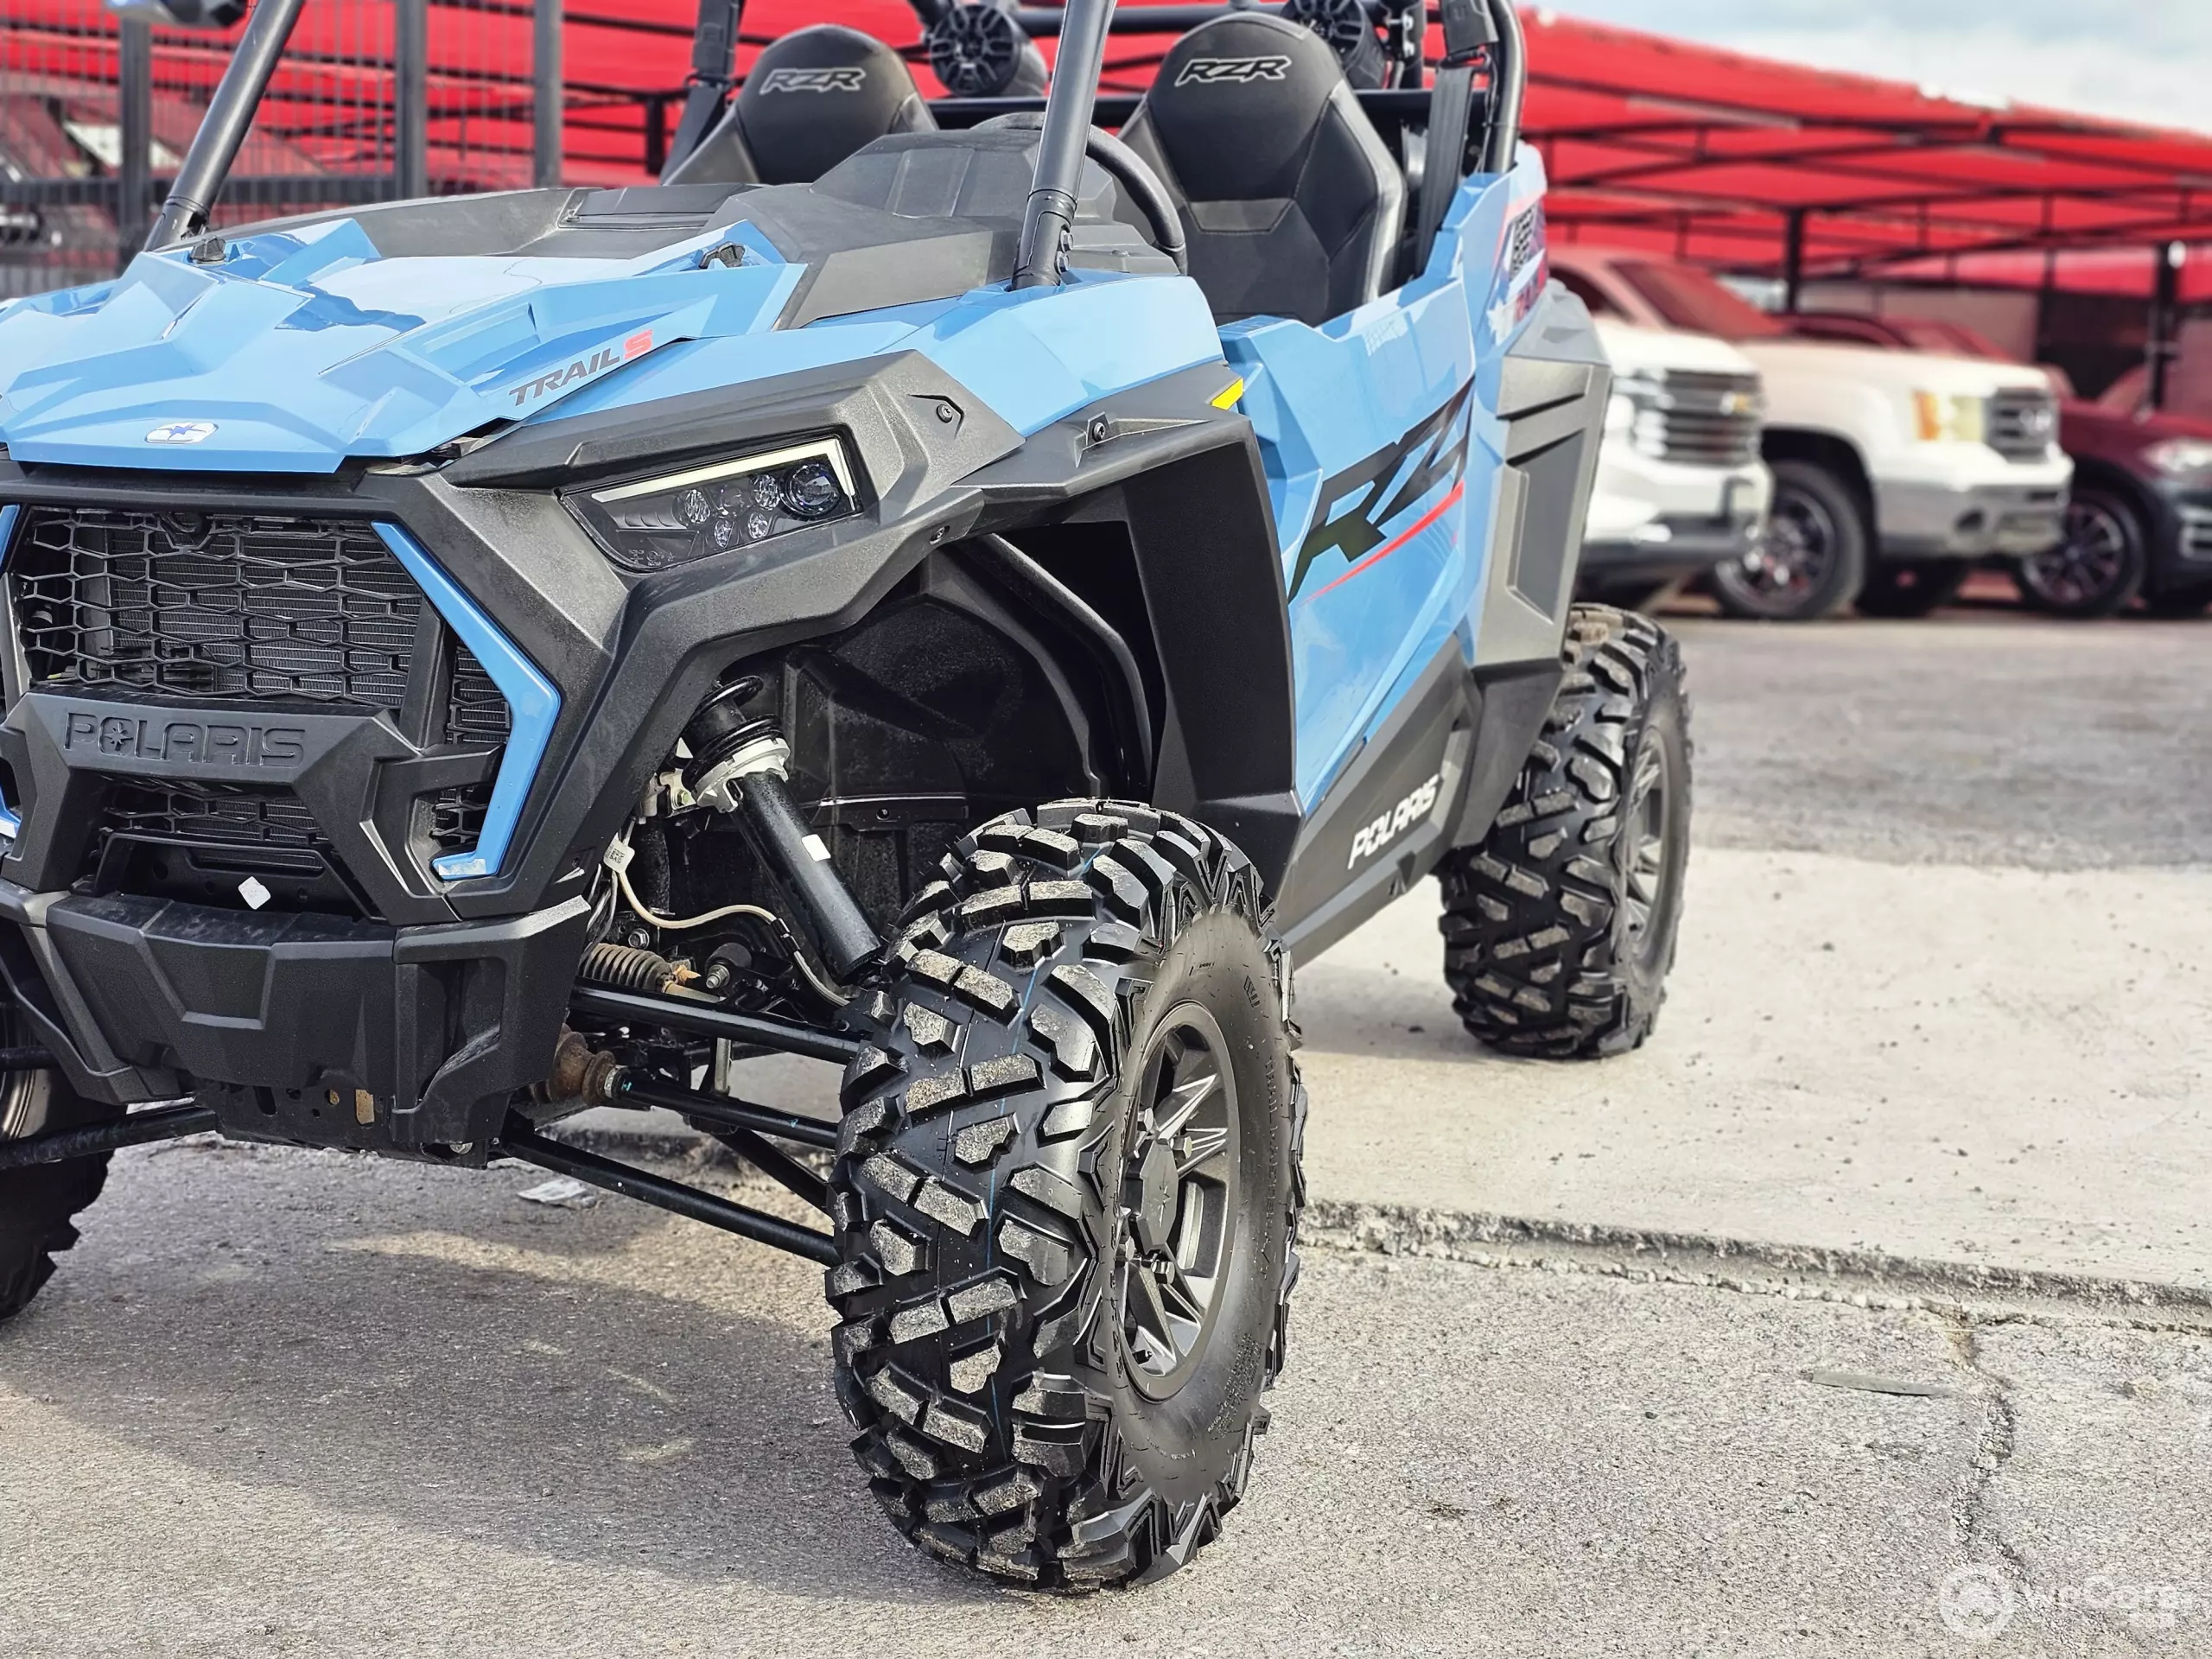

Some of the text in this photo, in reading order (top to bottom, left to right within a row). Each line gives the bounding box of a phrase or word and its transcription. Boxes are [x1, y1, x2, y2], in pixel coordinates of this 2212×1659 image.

[759, 67, 867, 95] RZR
[1174, 55, 1292, 86] RZR
[509, 329, 653, 406] TRAIL S
[1287, 374, 1474, 606] RZ
[64, 713, 307, 768] POLARIS
[1347, 773, 1440, 870] POLARIS
